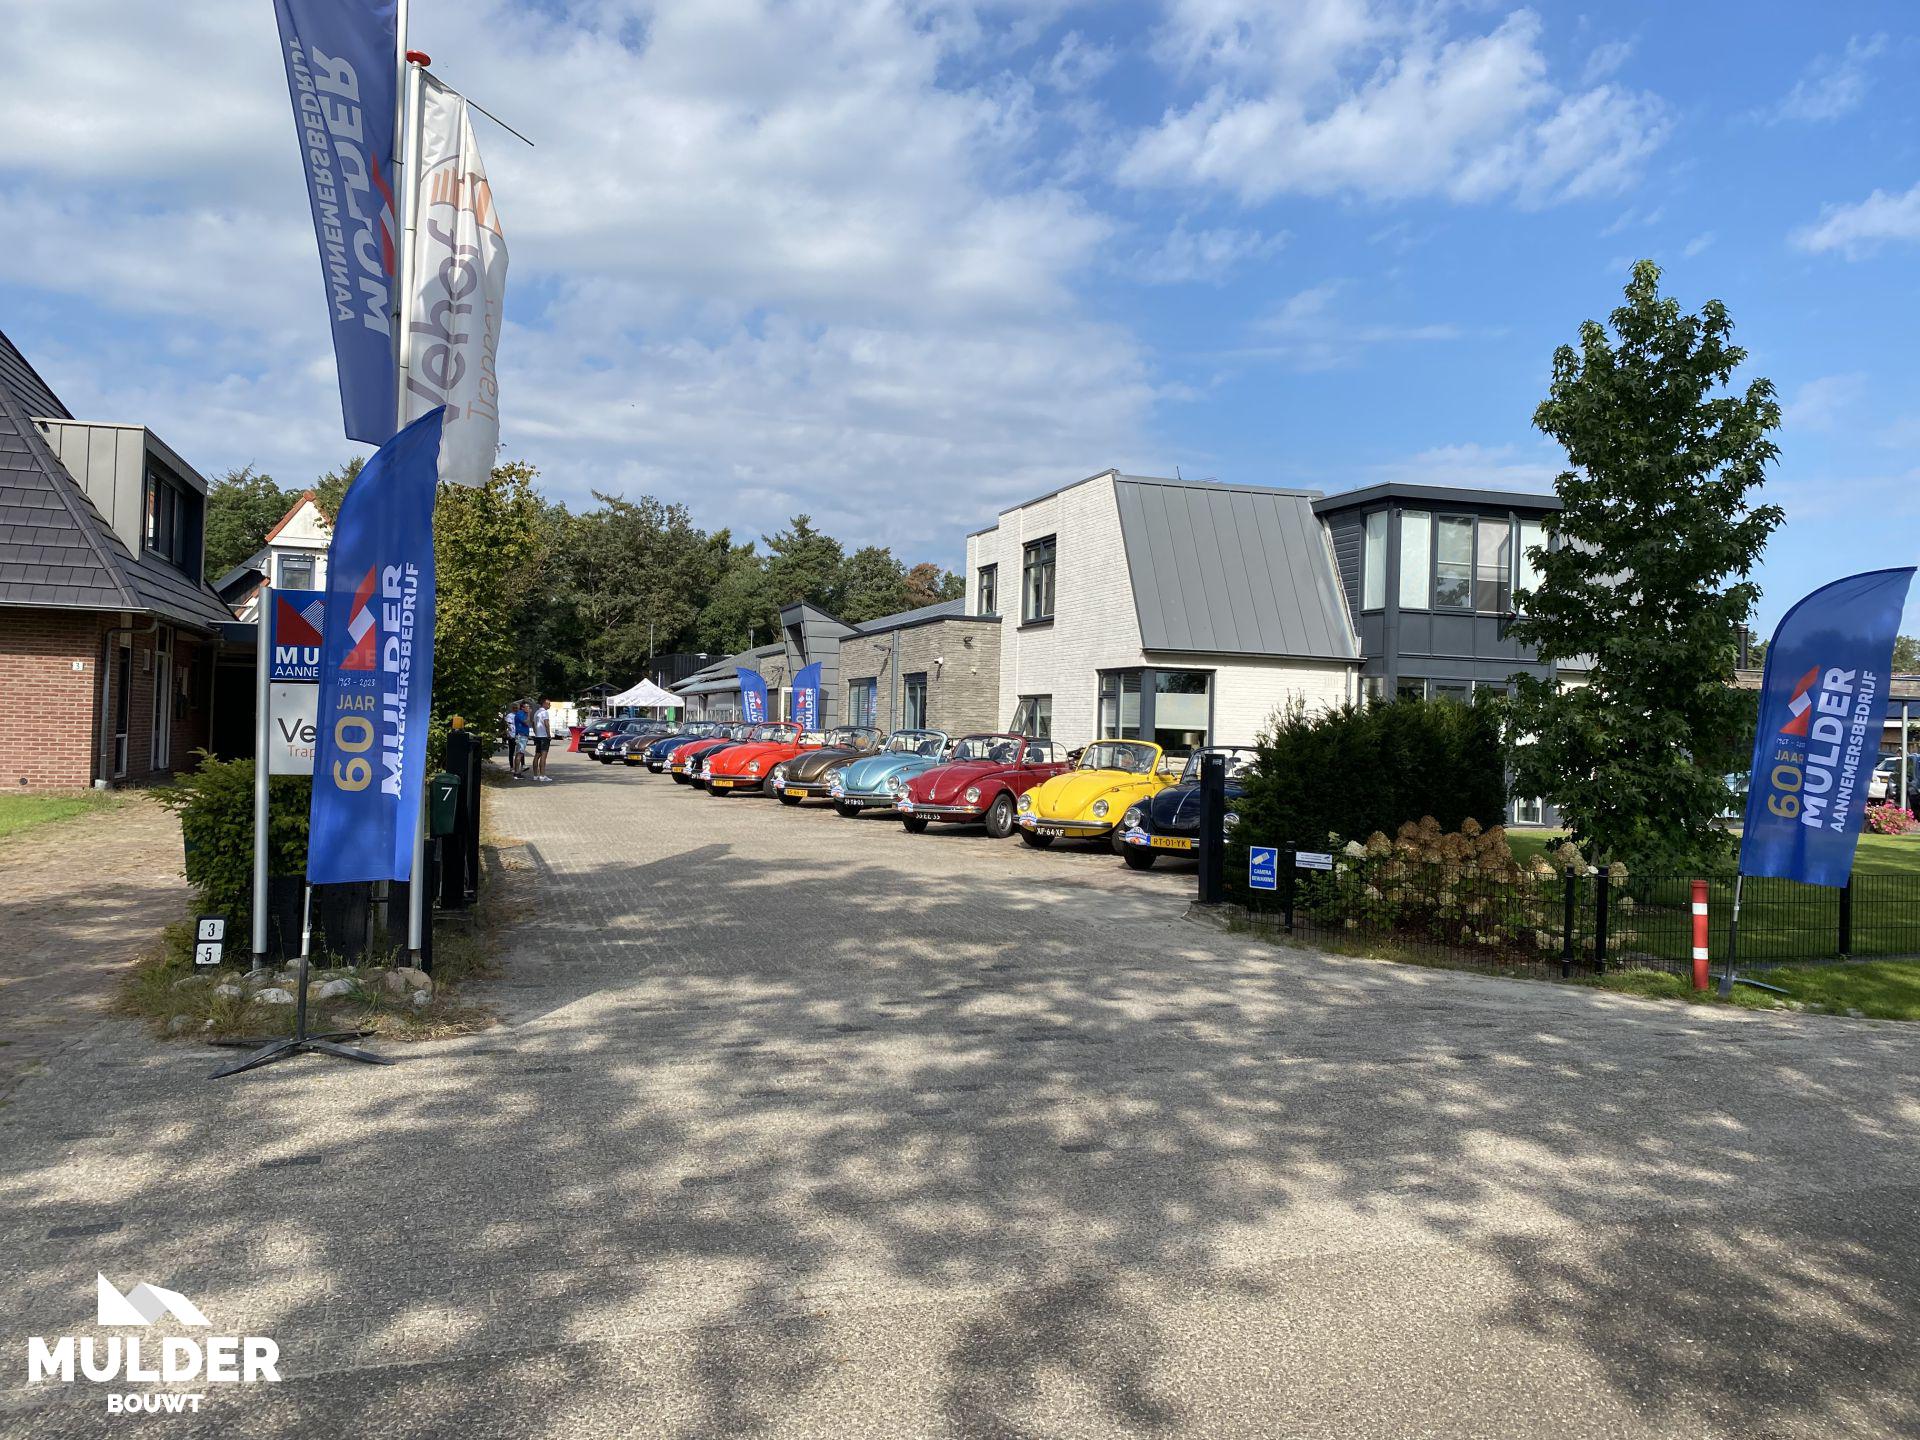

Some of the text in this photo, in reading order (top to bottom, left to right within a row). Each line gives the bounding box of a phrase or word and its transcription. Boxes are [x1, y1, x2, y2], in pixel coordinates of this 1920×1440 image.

[381, 564, 402, 796] MULDER
[336, 694, 375, 711] JAAR
[805, 688, 813, 730] MULDER
[333, 716, 375, 792] 60
[1774, 750, 1804, 764] JAAR
[1801, 667, 1856, 828] MULDER
[1830, 670, 1877, 833] AANNEMERSBEDRIJF
[441, 787, 452, 801] 7
[1767, 765, 1803, 818] 60
[1153, 837, 1187, 848] RT-01-YK
[208, 922, 215, 937] 3
[205, 947, 212, 962] 5
